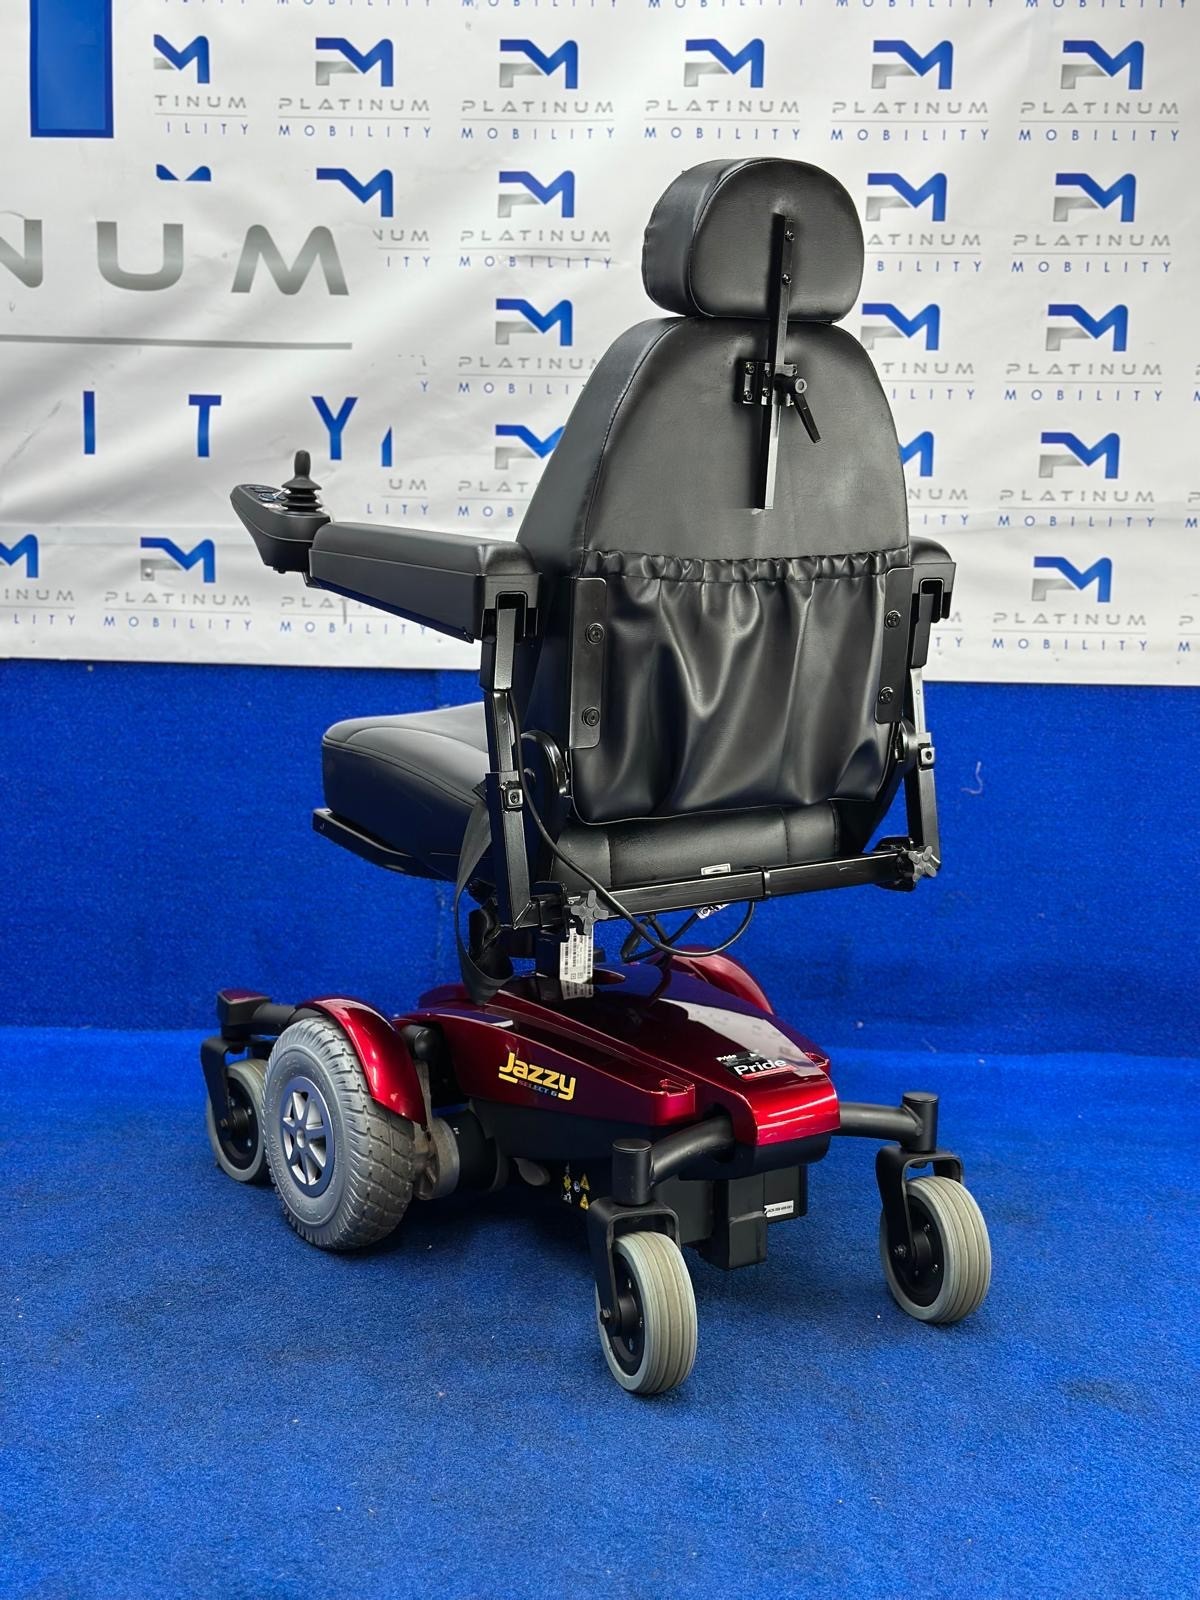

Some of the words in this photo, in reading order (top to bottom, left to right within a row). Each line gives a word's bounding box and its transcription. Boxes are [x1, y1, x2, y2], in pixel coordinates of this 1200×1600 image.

[279, 98, 429, 111] PLATINUM
[462, 100, 613, 113] PLATINUM
[646, 100, 799, 113] PLATINUM
[832, 102, 988, 114] PLATINUM
[1021, 102, 1178, 114] PLATINUM
[279, 124, 431, 138] MOBILITY
[461, 127, 614, 140] MOBILITY
[644, 127, 800, 140] MOBILITY
[831, 128, 989, 141] MOBILITY
[1019, 129, 1179, 141] MOBILITY
[461, 230, 610, 242] PLATINUM
[867, 234, 981, 246] ATINUM
[1013, 234, 1170, 246] PLATINUM
[459, 255, 612, 269] MOBILITY
[877, 260, 981, 272] BILITY
[1011, 261, 1171, 272] MOBILITY
[882, 362, 974, 374] TINUM
[1006, 363, 1162, 375] PLATINUM
[458, 382, 568, 396] MOBILI
[893, 389, 974, 400] ILITY
[1004, 389, 1162, 401] MOBILITY
[459, 481, 528, 492] PLAT
[1000, 490, 1154, 503] PLATINUM
[998, 515, 1155, 528] MOBILITY
[5, 589, 74, 601] INUM
[105, 592, 250, 606] PLATINUM
[281, 596, 350, 609] PLAT
[14, 613, 75, 625] LITY
[104, 616, 251, 630] MOBILITY
[993, 613, 1146, 625] PLATINUM
[280, 621, 426, 635] MOBILITY
[992, 638, 1147, 651] MOBILITY
[734, 1060, 787, 1075] Pride
[499, 1052, 576, 1101] Jazzy
